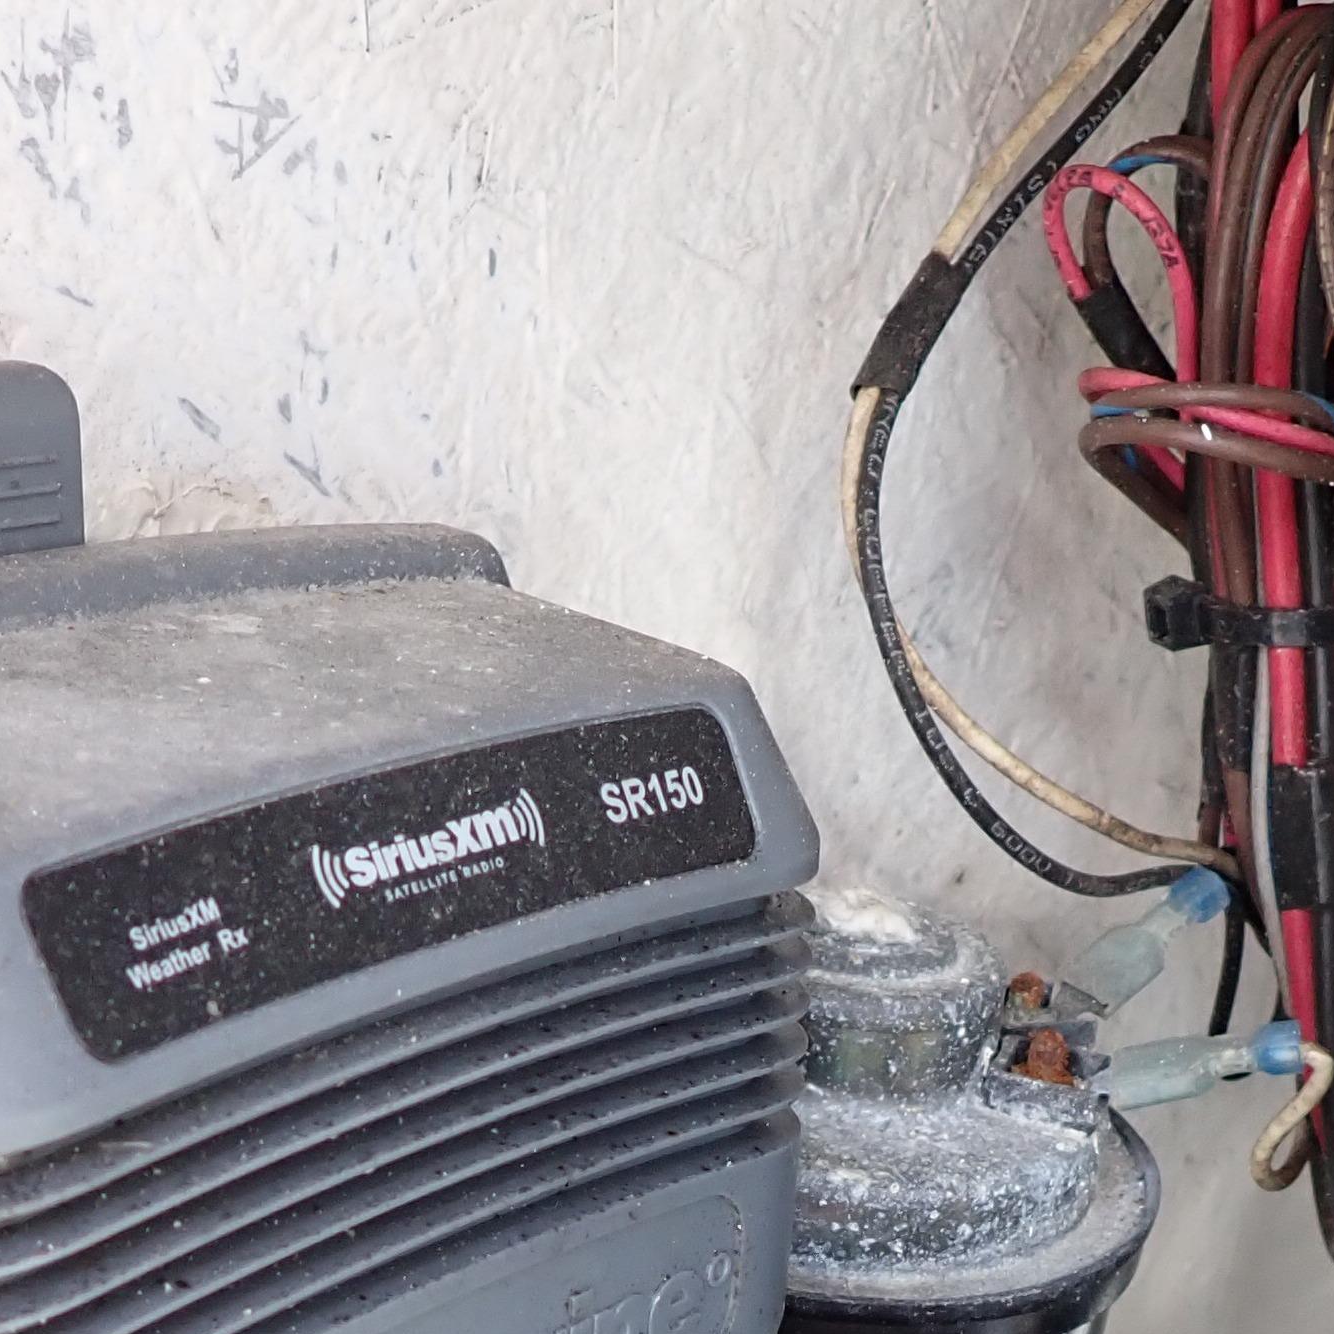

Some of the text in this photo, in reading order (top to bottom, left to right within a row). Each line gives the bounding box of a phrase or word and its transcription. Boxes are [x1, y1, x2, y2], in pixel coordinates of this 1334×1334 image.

[601, 766, 705, 824] SR150
[384, 855, 505, 903] SATELLITE RADIO
[128, 896, 222, 951] SiriusXM
[125, 926, 250, 990] Weather Rx
